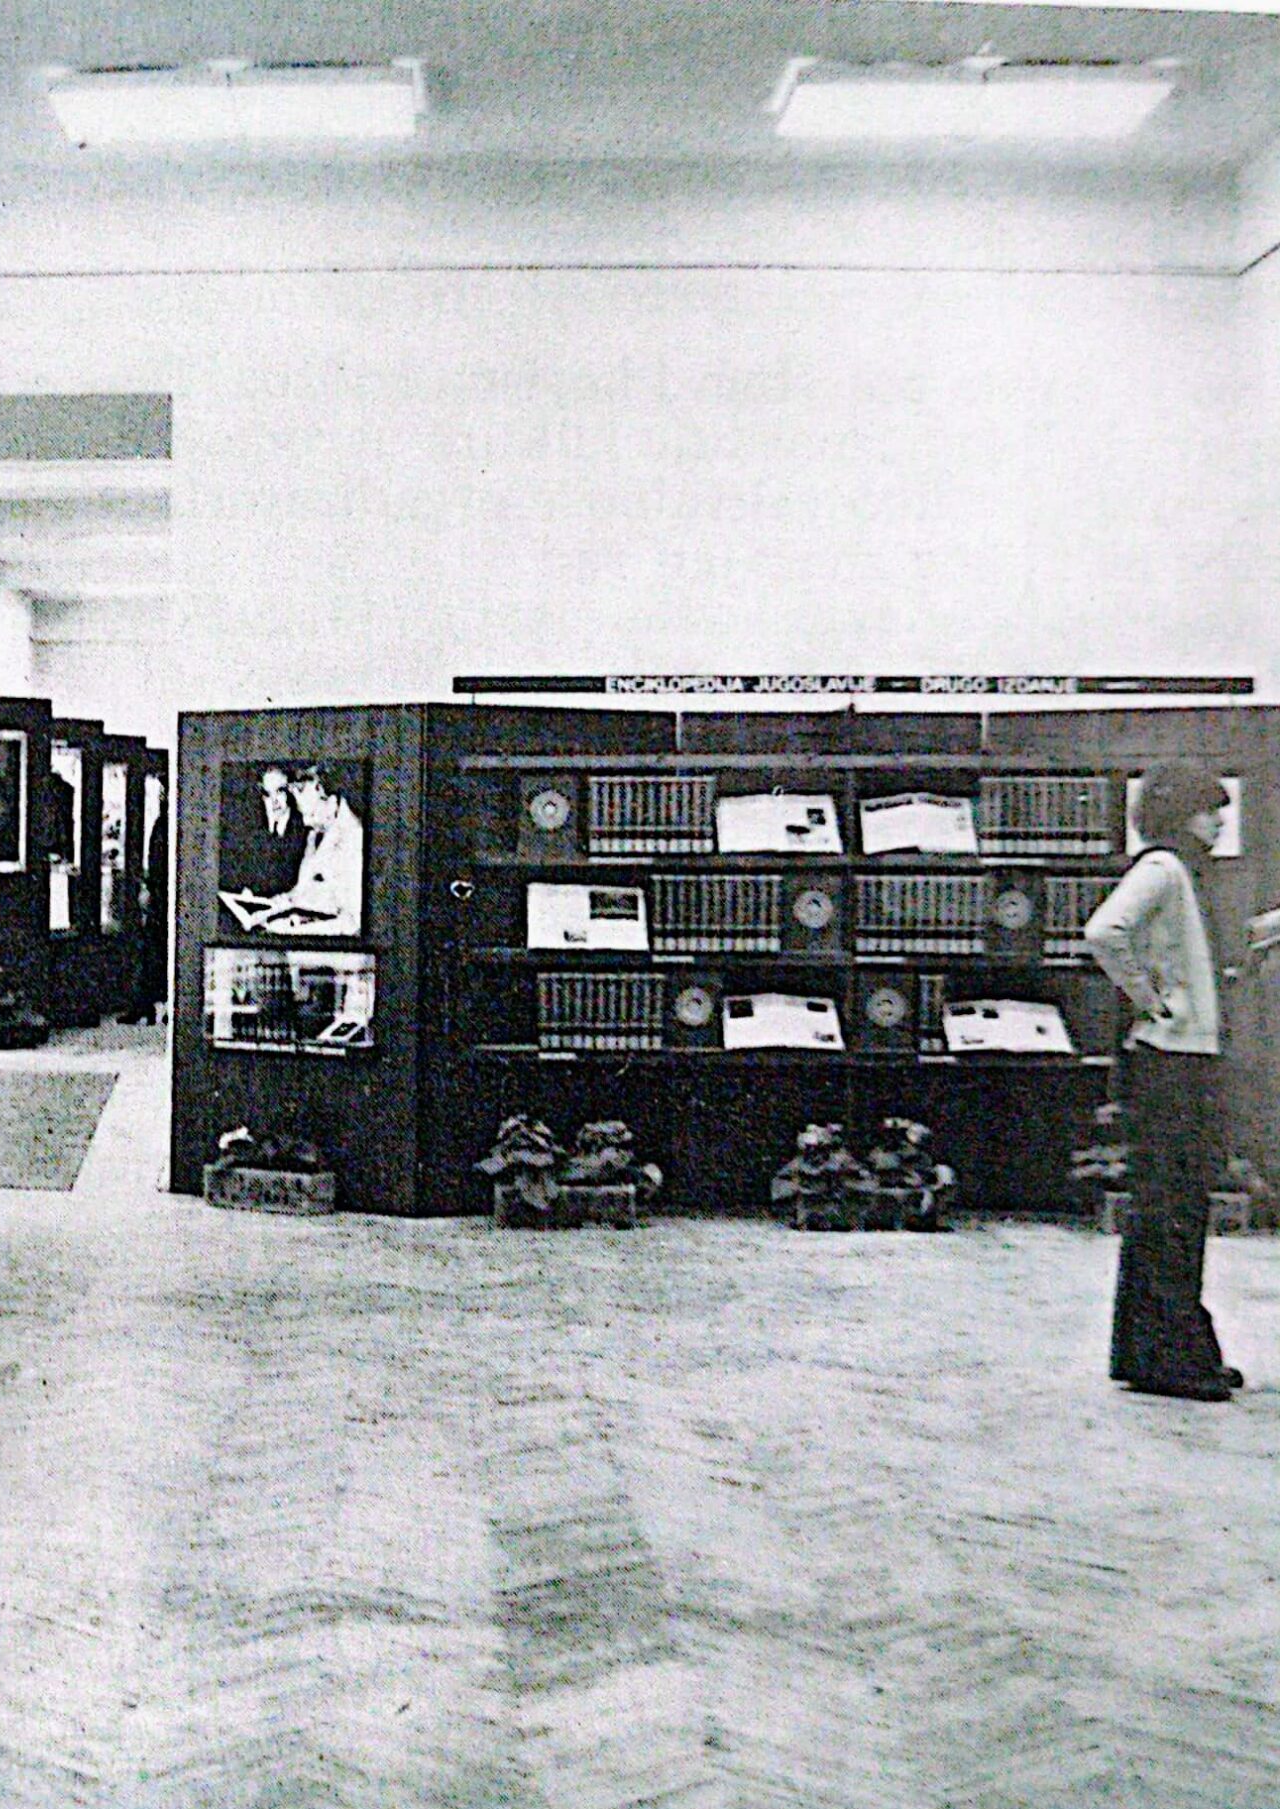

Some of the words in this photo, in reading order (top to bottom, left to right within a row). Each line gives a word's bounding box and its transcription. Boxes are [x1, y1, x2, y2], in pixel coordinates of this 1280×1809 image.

[753, 676, 876, 693] JUGOSLAVIJE
[920, 676, 986, 693] DRUGO
[997, 677, 1077, 694] IZDANJE
